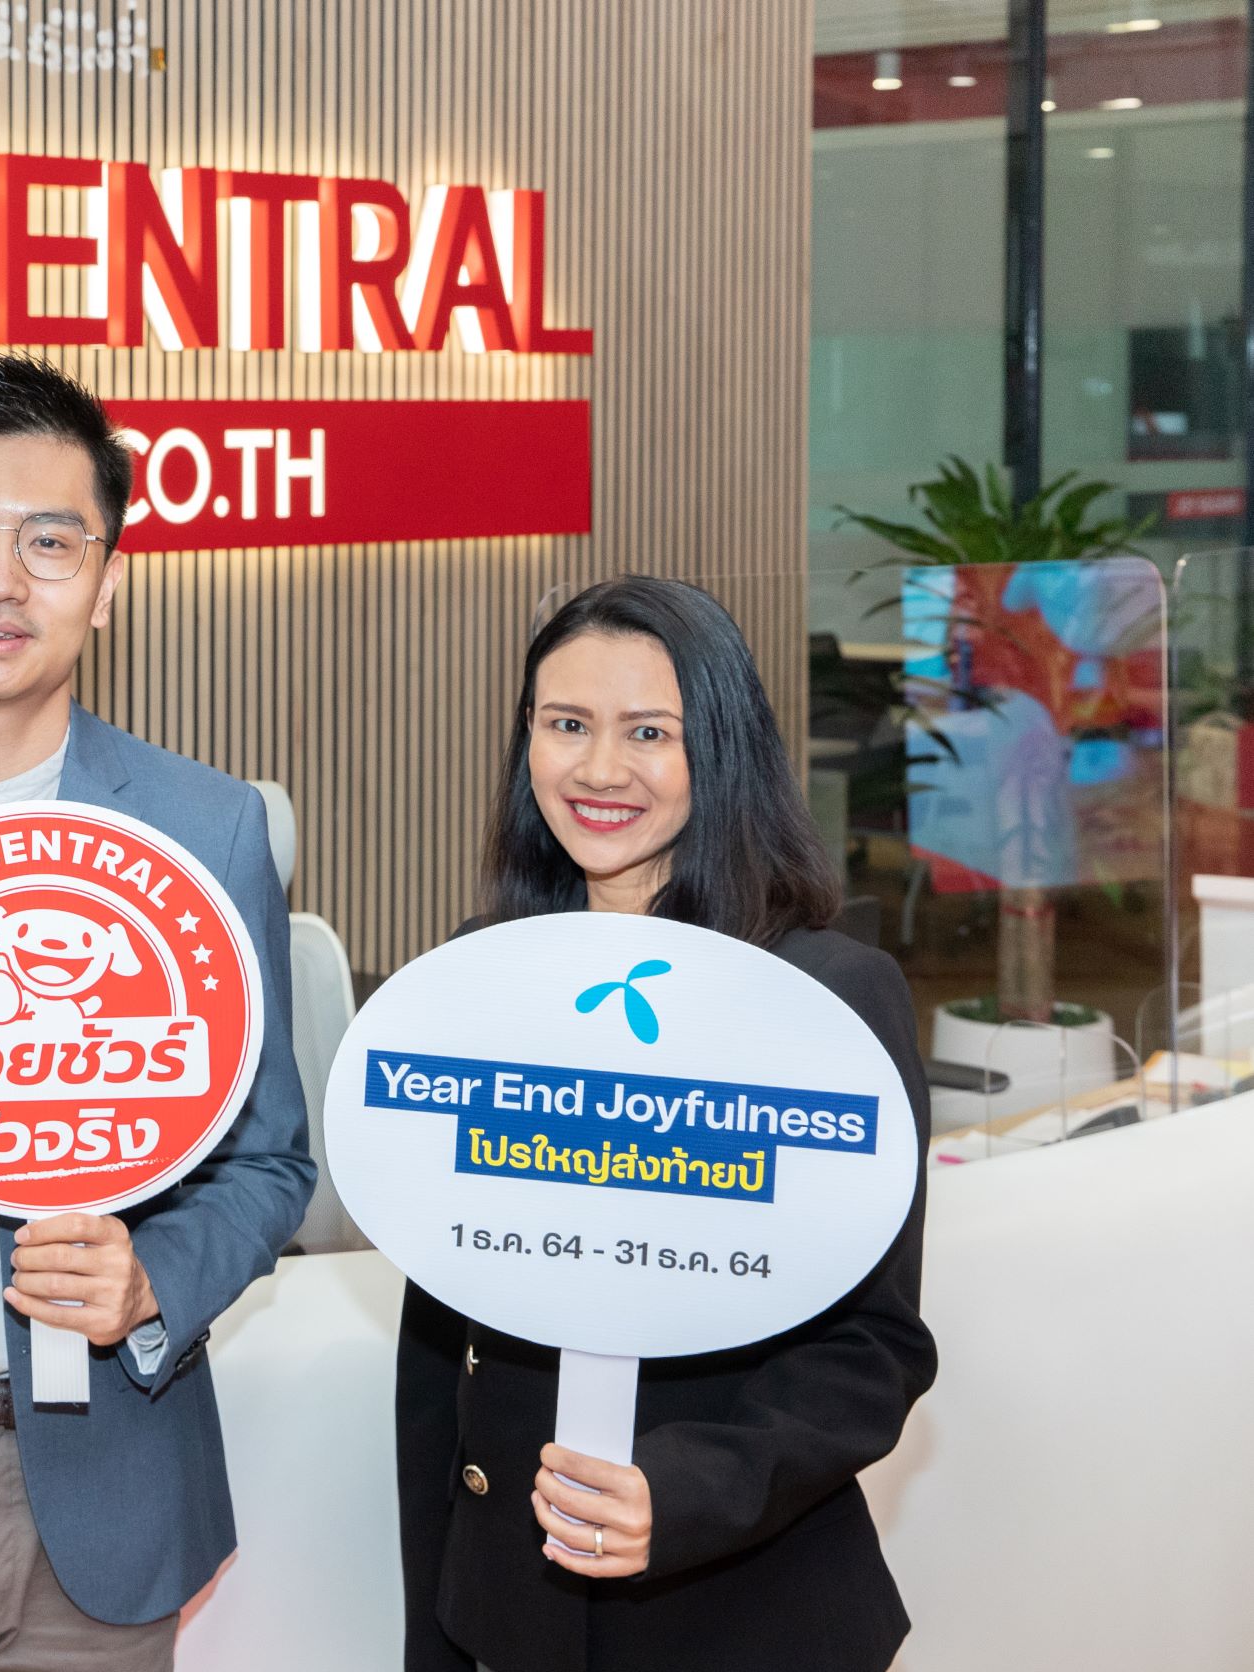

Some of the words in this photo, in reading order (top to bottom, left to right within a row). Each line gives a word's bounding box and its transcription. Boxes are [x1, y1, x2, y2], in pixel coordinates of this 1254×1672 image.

[377, 1060, 482, 1105] Year
[493, 1072, 585, 1116] End
[595, 1083, 866, 1143] Joyfulness
[468, 1127, 766, 1192] โปรใหญ่ส่งท้ายปี
[542, 1232, 583, 1259] 64
[729, 1251, 772, 1279] 64
